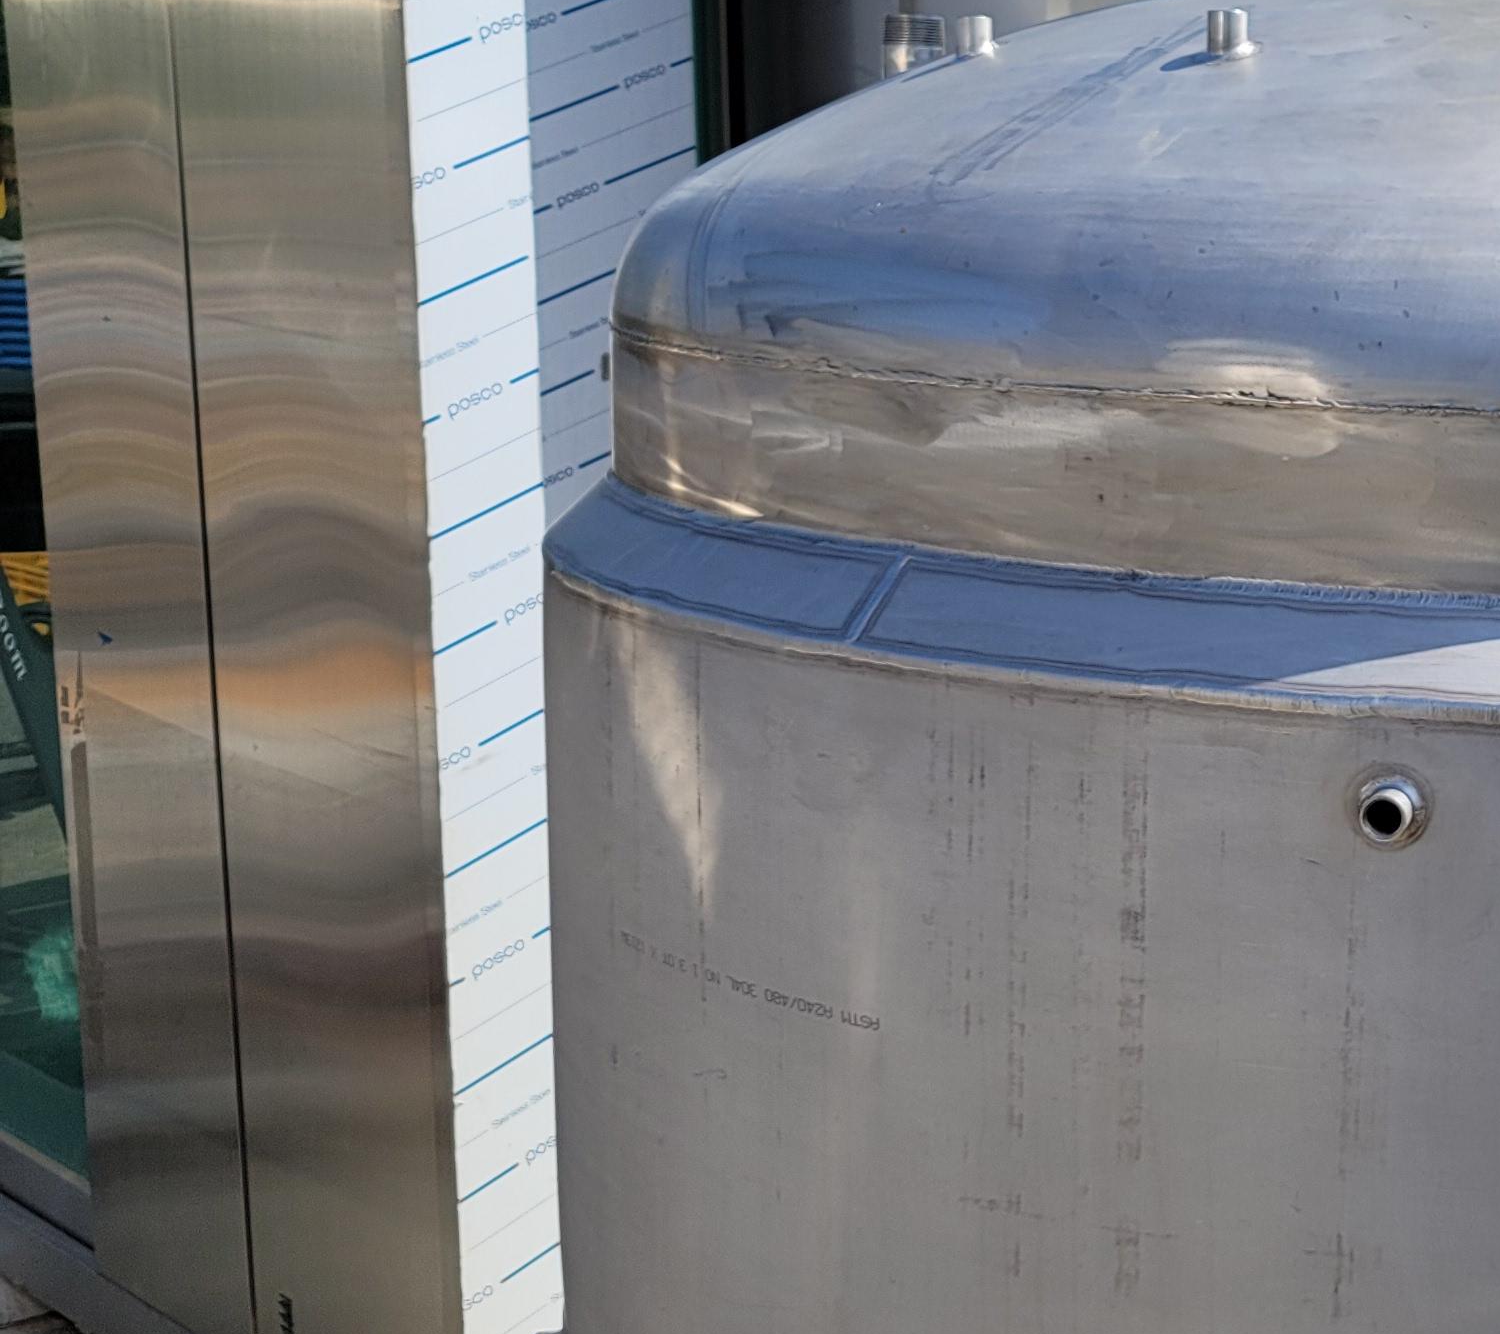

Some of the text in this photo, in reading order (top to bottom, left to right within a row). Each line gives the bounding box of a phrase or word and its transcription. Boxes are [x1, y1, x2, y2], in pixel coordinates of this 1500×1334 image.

[479, 12, 524, 44] posc
[623, 64, 666, 91] posco
[411, 166, 446, 189] sco
[556, 182, 600, 209] posco
[448, 382, 503, 420] posco
[504, 592, 544, 626] posc
[439, 746, 471, 770] sco
[471, 939, 525, 981] posco
[840, 1010, 880, 1030] ASTM
[525, 1136, 557, 1166] pos
[462, 1284, 494, 1311] sco
